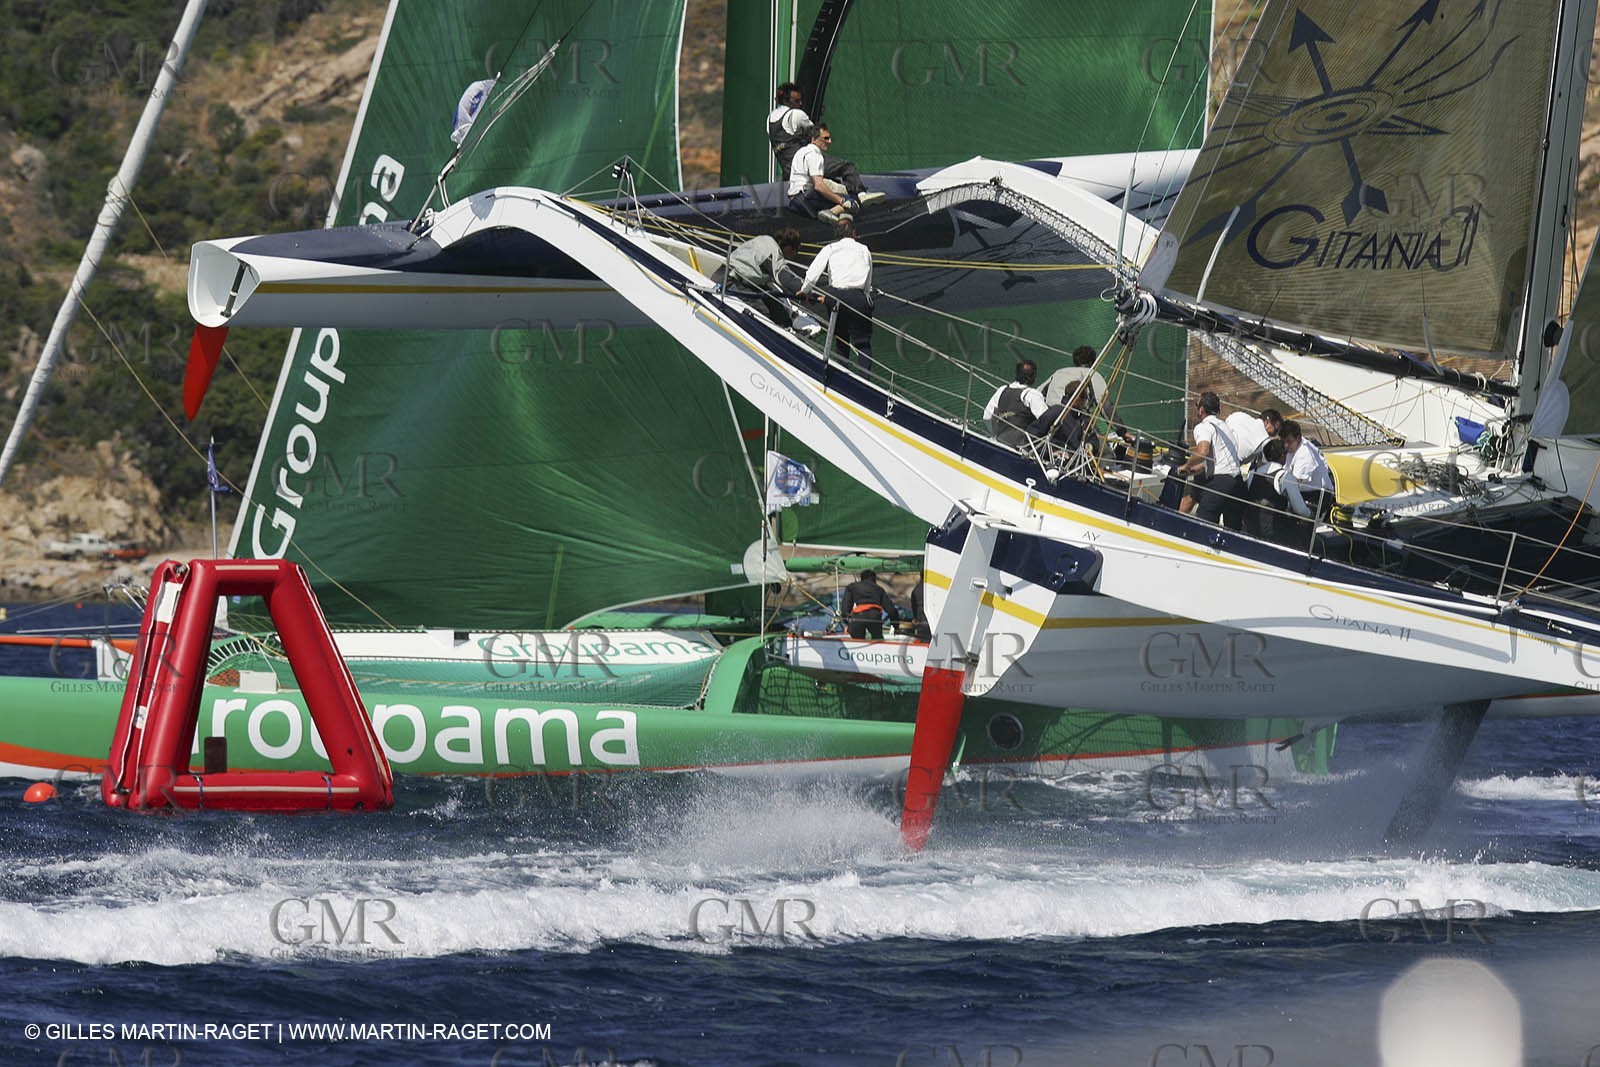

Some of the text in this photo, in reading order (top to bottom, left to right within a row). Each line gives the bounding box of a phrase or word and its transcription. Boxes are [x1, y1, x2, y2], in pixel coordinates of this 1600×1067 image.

[1247, 204, 1442, 270] GITANA
[750, 372, 814, 419] GITANA II
[1309, 604, 1411, 642] GITANA II
[477, 636, 712, 663] Groupama
[838, 646, 914, 666] Groupama
[191, 696, 641, 766] ropama
